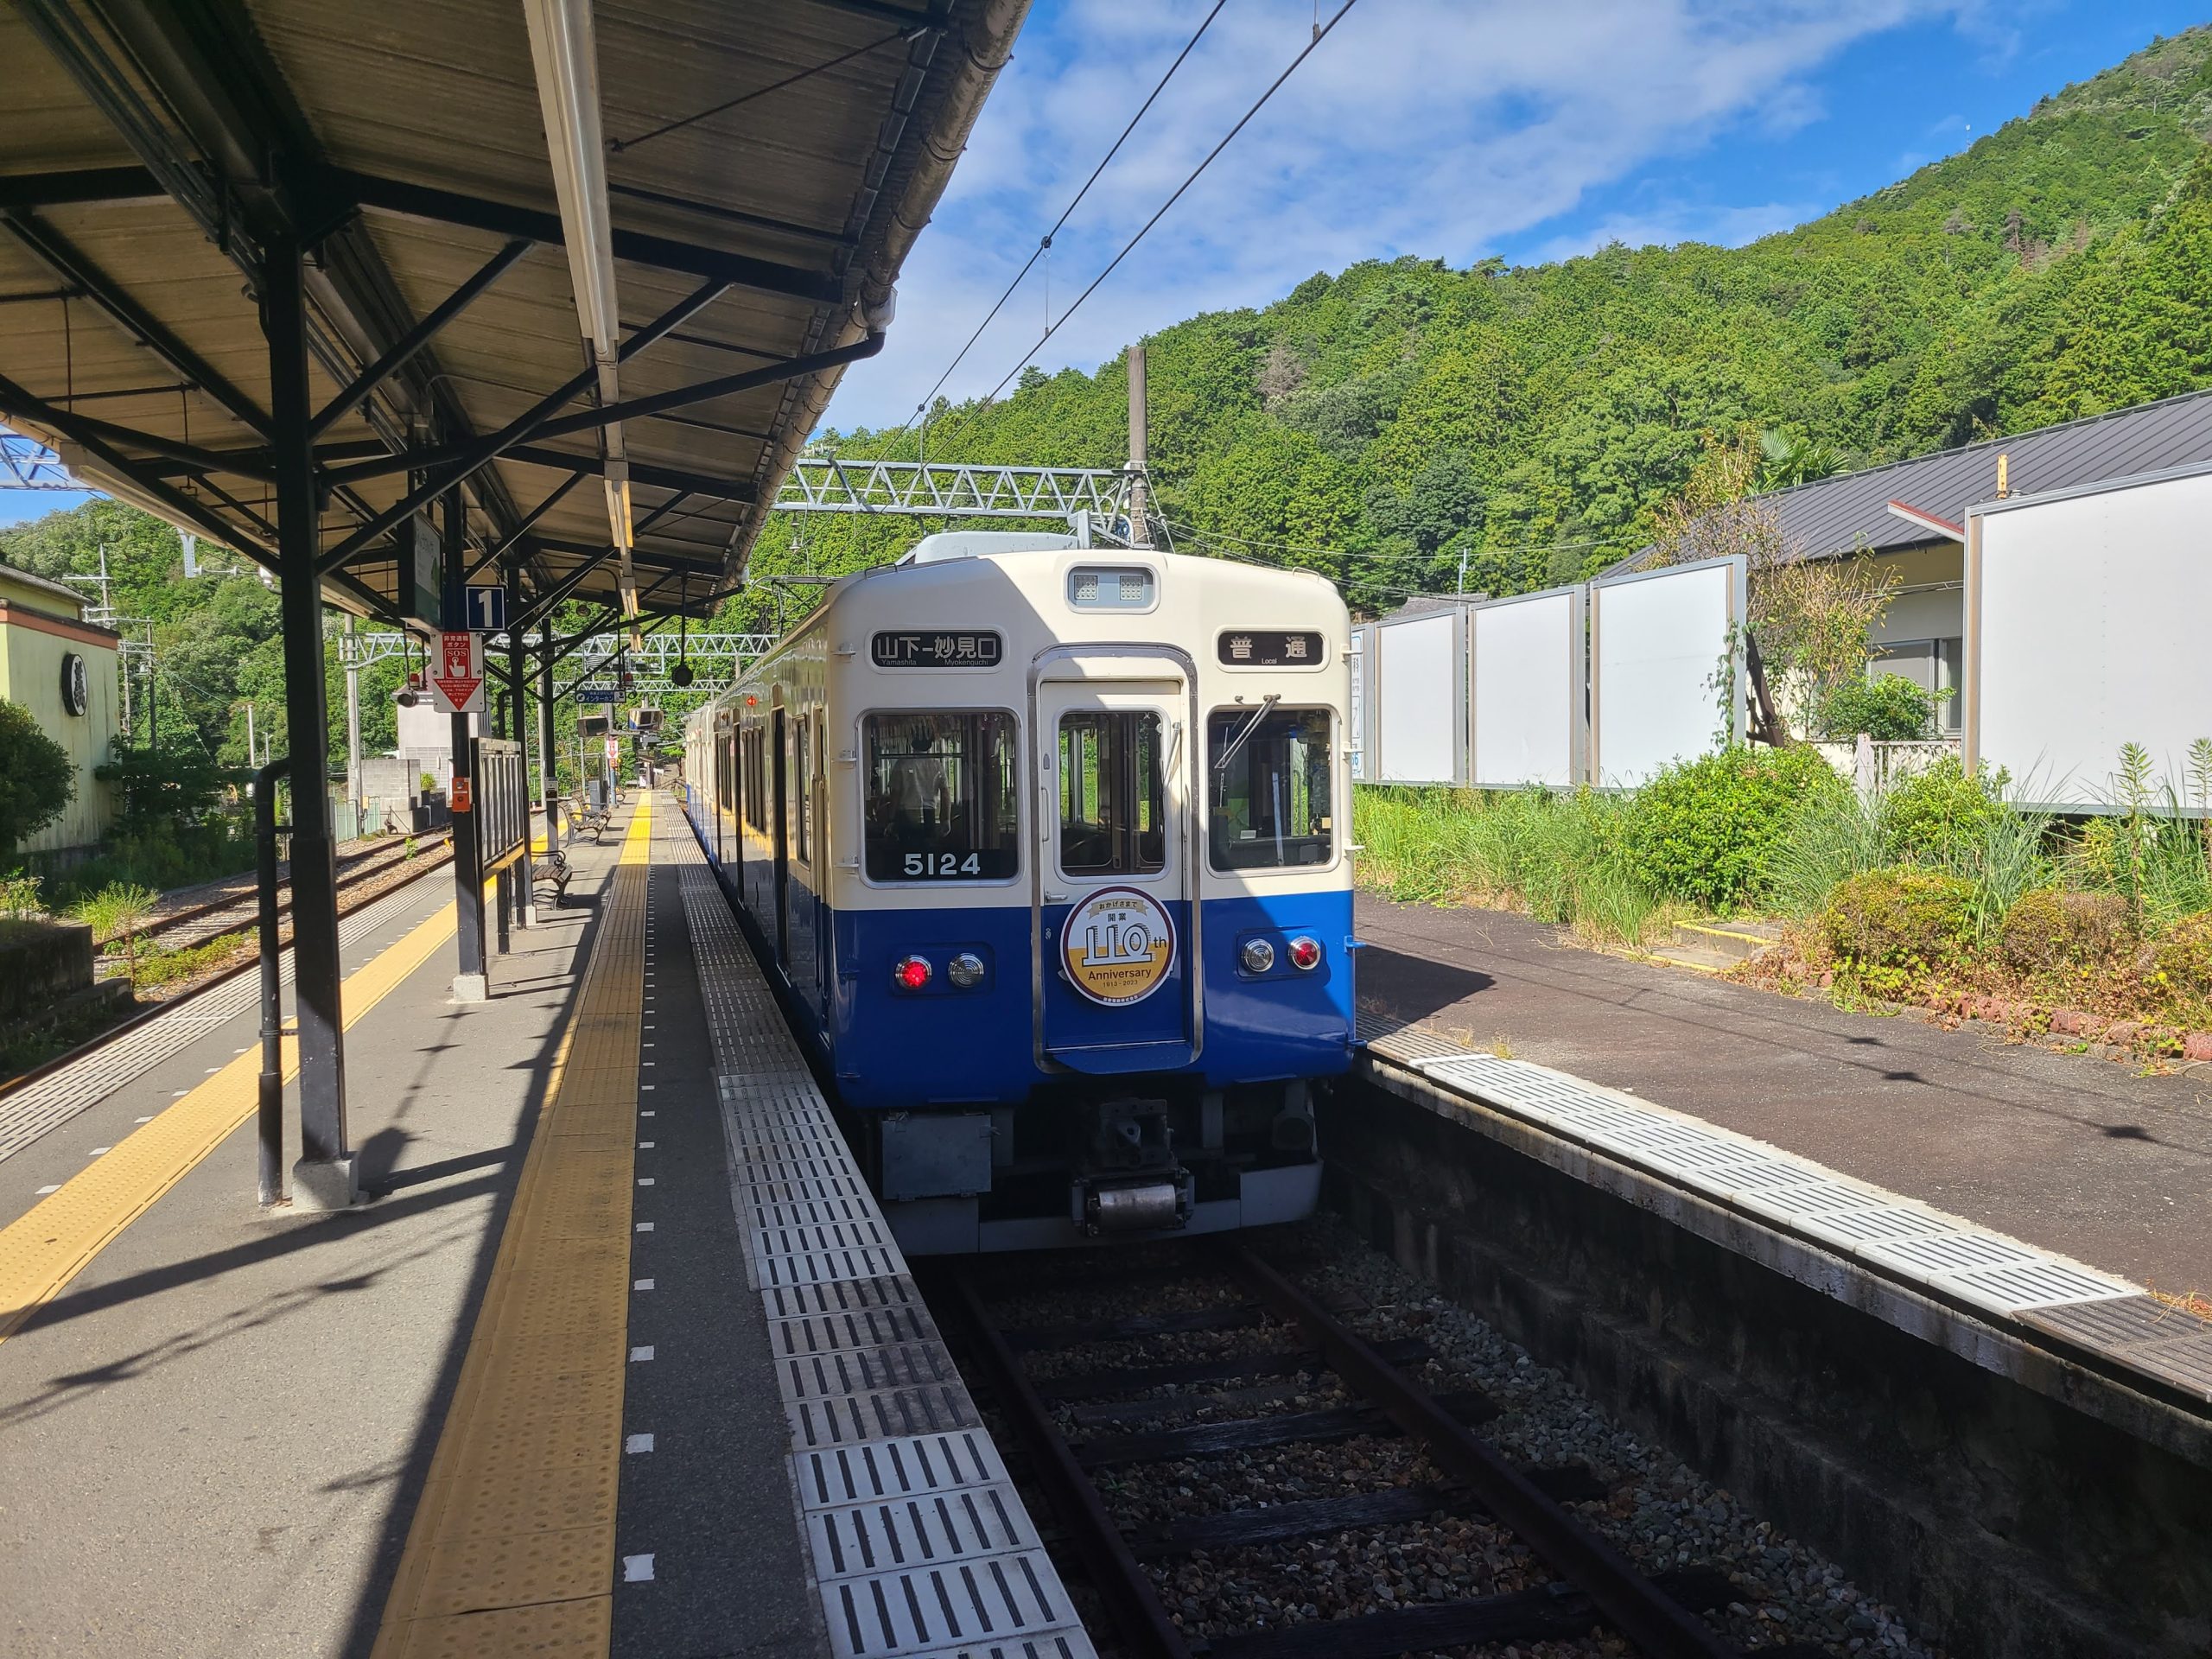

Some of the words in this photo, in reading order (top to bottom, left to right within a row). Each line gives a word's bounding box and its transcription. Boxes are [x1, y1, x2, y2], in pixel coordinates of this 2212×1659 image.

[478, 589, 493, 627] 1
[903, 852, 982, 875] 5124
[1098, 900, 1139, 911] おかげさまで
[1107, 912, 1128, 922] 開業
[1088, 969, 1152, 981] Anniversary
